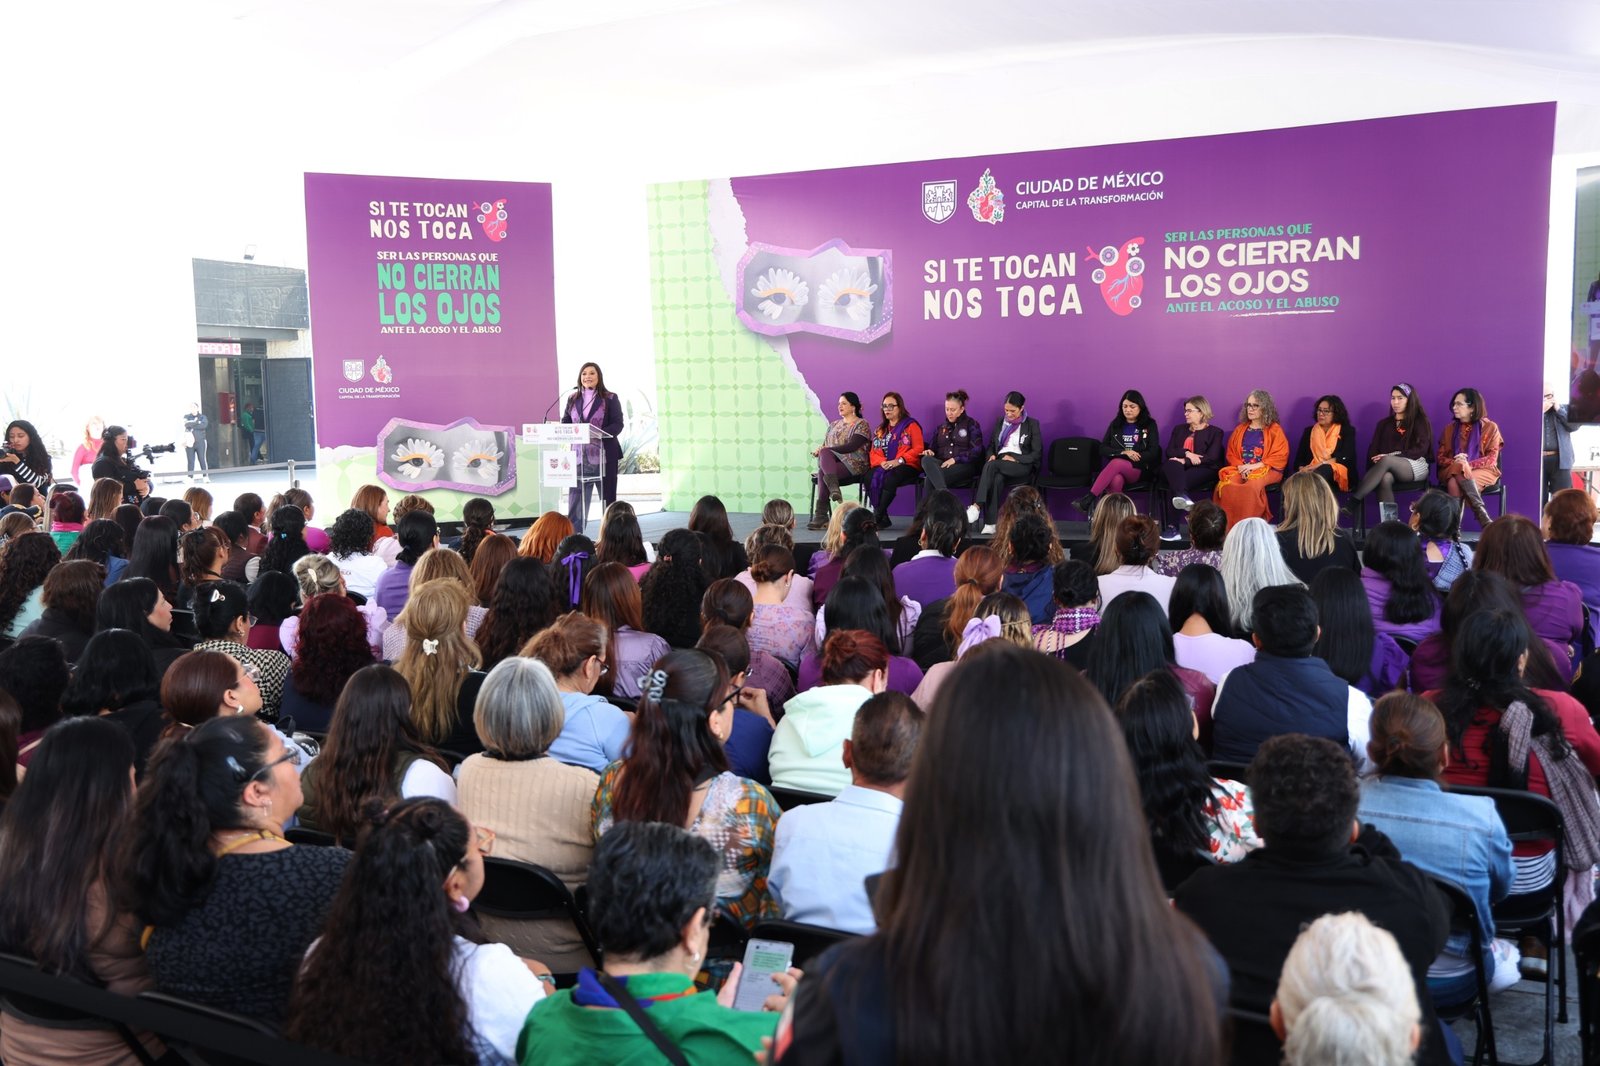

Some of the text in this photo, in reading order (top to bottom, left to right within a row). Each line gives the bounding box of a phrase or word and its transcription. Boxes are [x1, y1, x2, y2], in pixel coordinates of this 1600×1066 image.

[1016, 171, 1164, 195] CIUDAD DE MÉXICO
[369, 201, 468, 218] SI TE TOCAN
[1016, 190, 1163, 210] CAPITAL DE LA TRANSFORMACIÓN
[370, 219, 473, 240] NOS TOCA
[1164, 223, 1312, 243] SER LAS PERSONAS QUE
[377, 251, 498, 263] SER LAS PERSONAS QUE
[1164, 233, 1360, 270] NO CIERRAN
[377, 262, 500, 290] NO CIERRAN
[924, 252, 1076, 283] SI TE TOCAN
[1165, 268, 1309, 298] LOS OJOS
[379, 292, 501, 325] LOS OJOS
[924, 283, 1083, 320] NOS TOCA
[1166, 296, 1339, 313] ANTE EL ACOSO Y EL ABUSO
[381, 326, 405, 334] ANTE
[406, 326, 417, 334] EL
[419, 326, 450, 334] ACOSO
